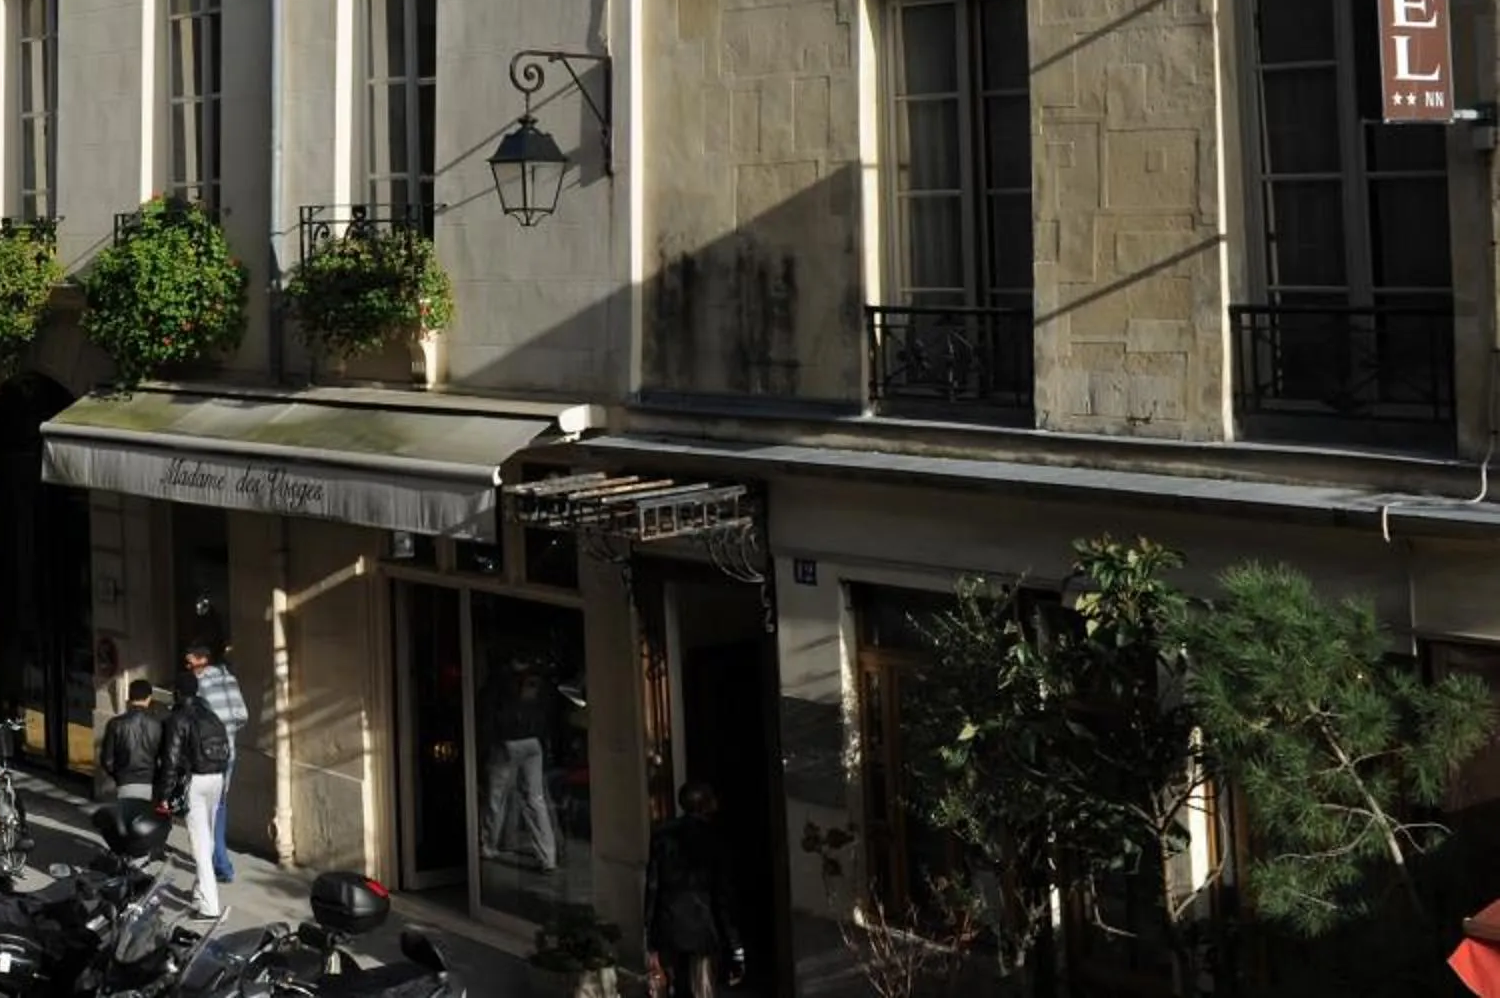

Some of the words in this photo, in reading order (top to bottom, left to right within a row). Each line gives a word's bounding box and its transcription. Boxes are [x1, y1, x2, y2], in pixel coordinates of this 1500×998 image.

[1425, 91, 1445, 107] NN
[160, 457, 225, 491] Madame
[235, 463, 261, 494] des
[263, 467, 324, 507] Vosges
